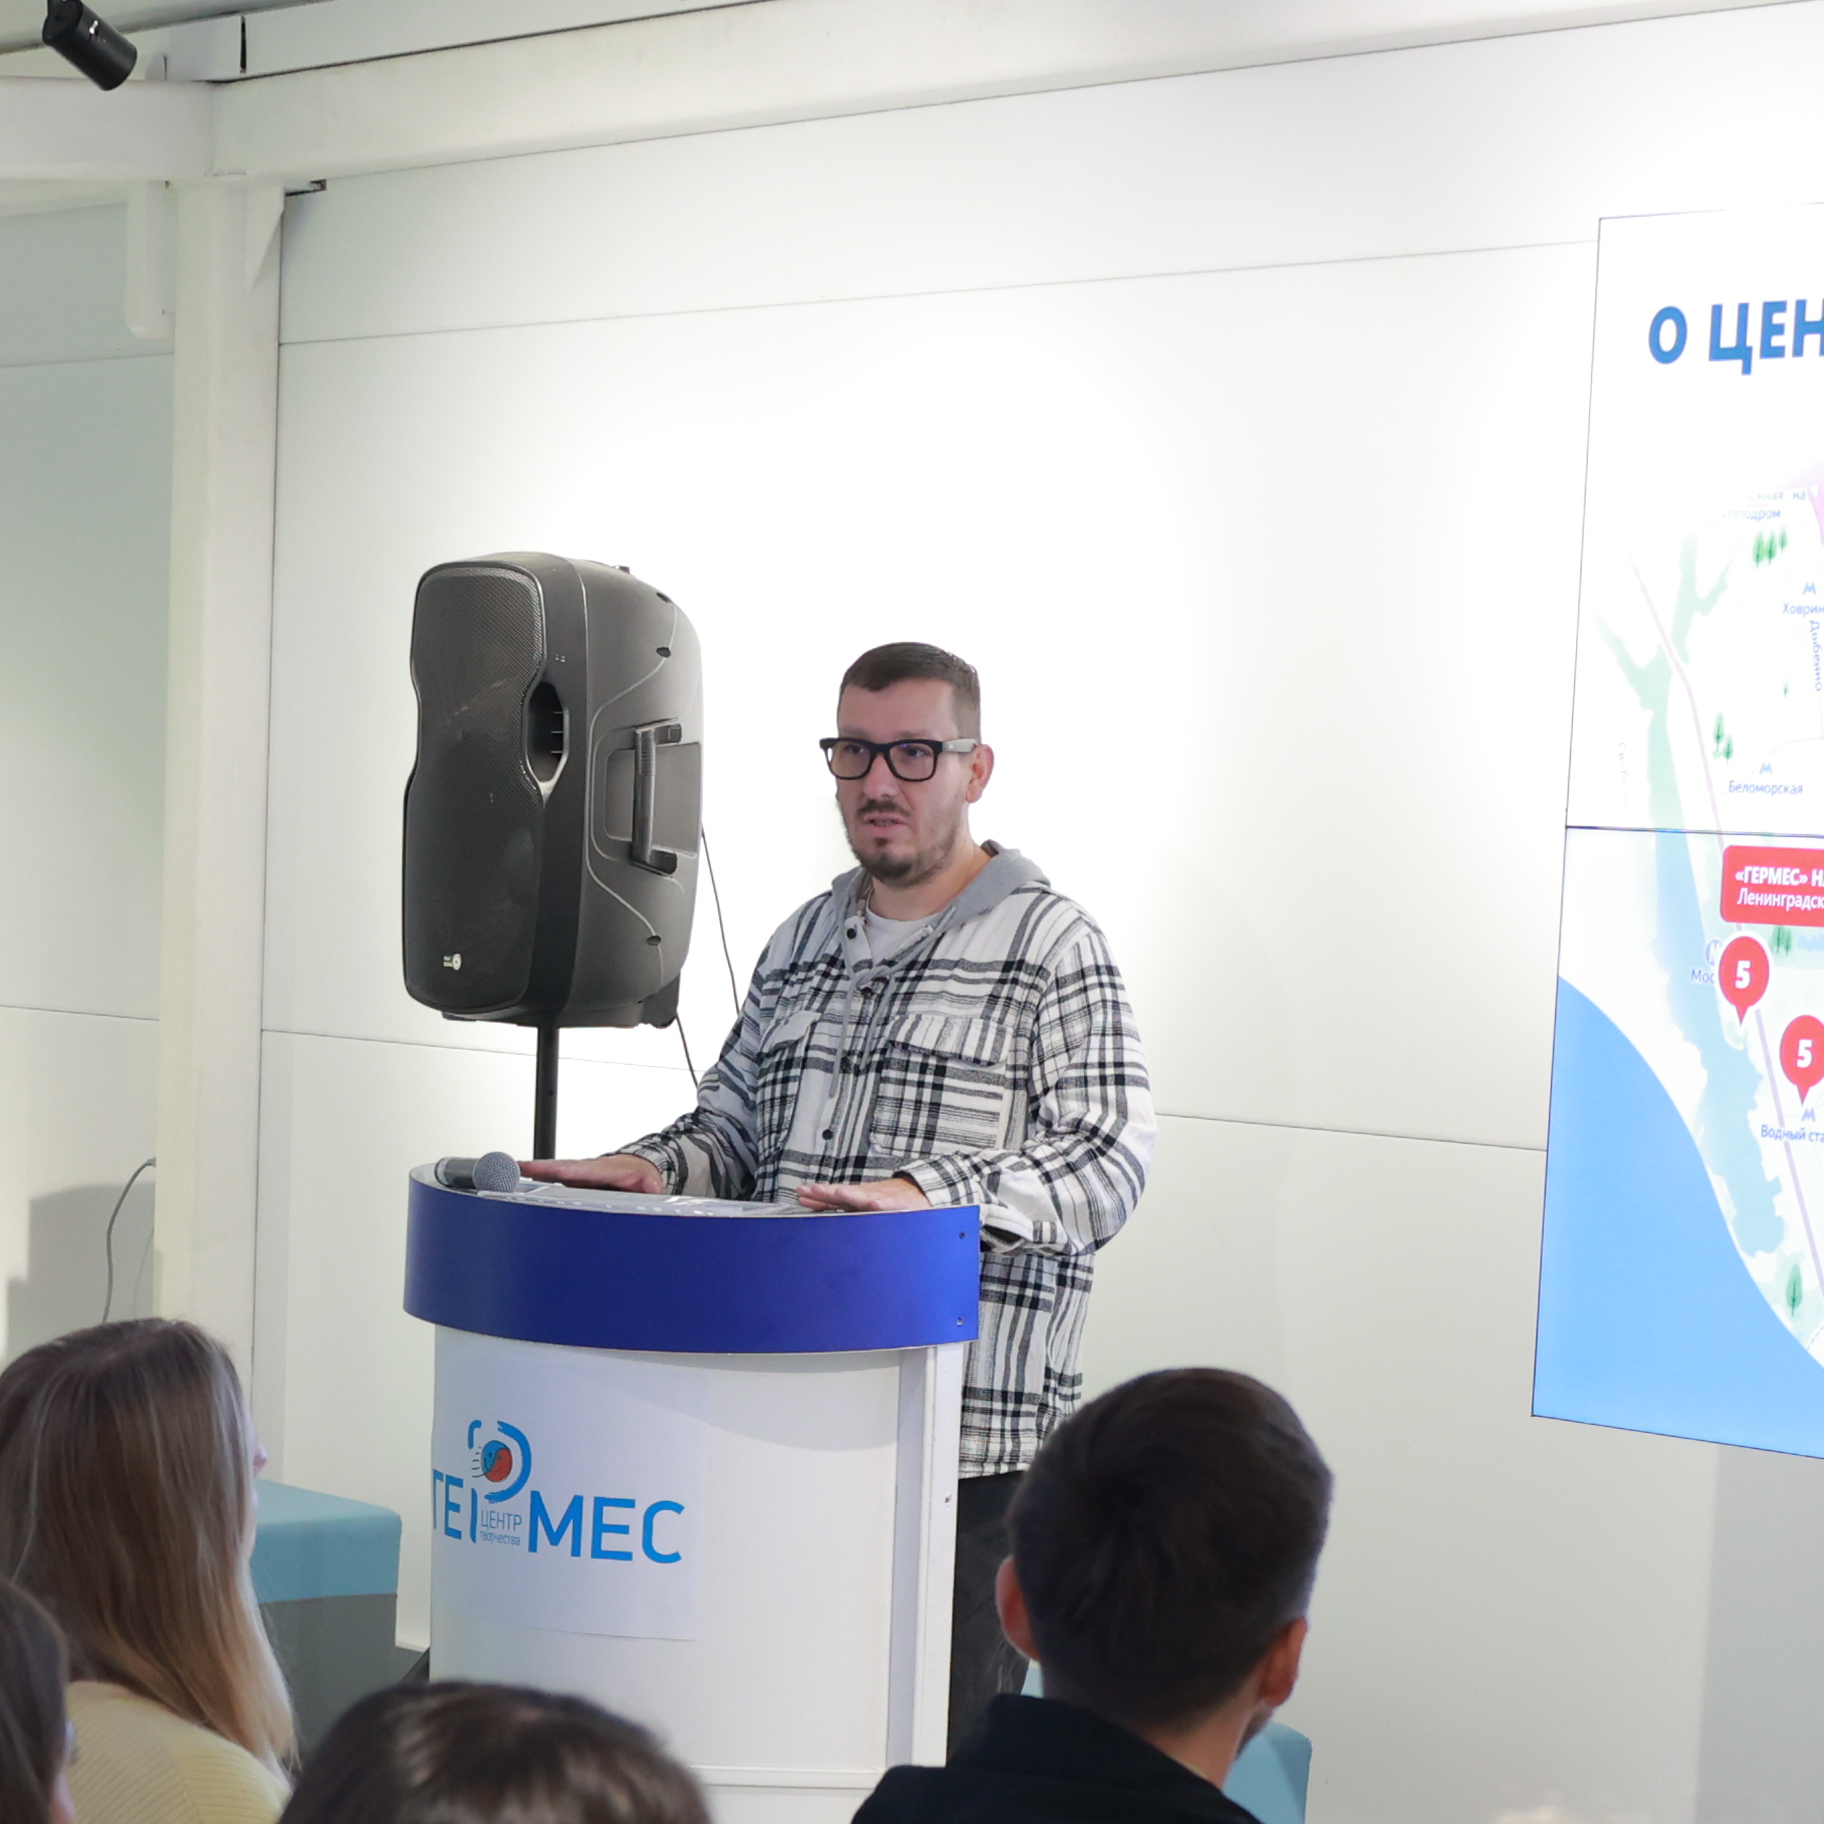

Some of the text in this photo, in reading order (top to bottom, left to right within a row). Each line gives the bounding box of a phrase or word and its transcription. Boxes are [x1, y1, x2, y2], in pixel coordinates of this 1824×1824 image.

[1648, 306, 1688, 365] О
[1728, 780, 1803, 796] Беломорская
[1736, 867, 1808, 888] «ГЕРМЕС»
[1735, 960, 1751, 988] 5
[1796, 1039, 1813, 1068] 5
[1760, 1124, 1807, 1144] Водный
[480, 1509, 523, 1532] ЦЕНТР
[479, 1530, 521, 1546] творчества
